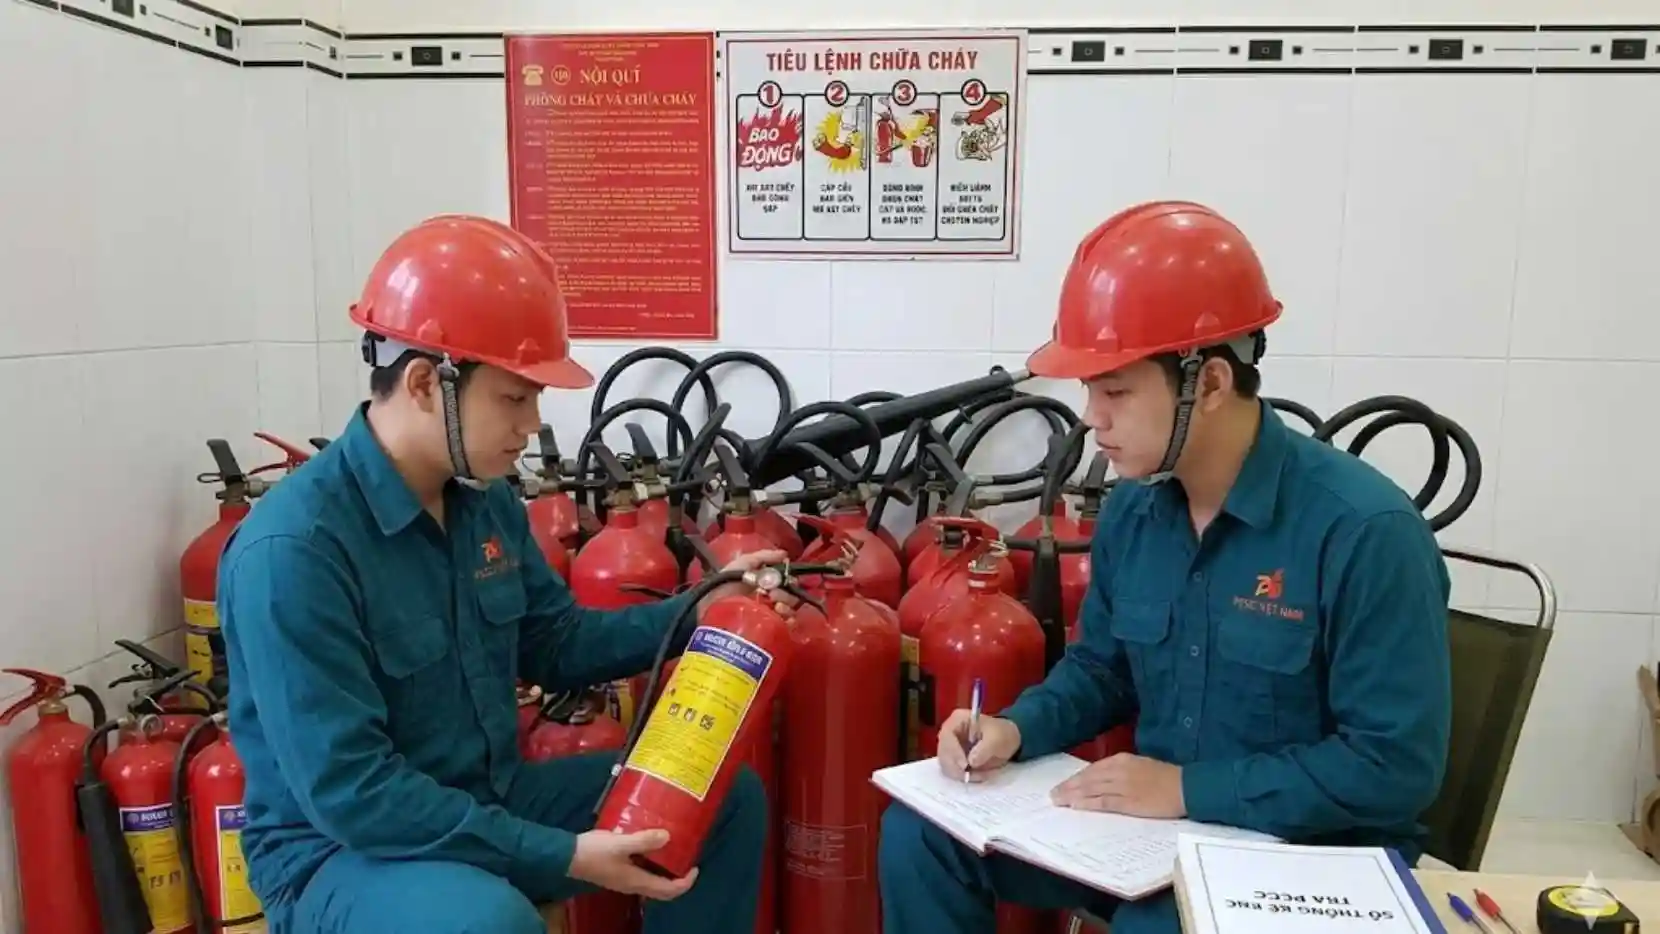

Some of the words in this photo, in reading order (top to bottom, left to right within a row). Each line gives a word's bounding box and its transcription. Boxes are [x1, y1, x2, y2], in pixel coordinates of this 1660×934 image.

[766, 48, 806, 71] TIÊU
[814, 48, 861, 75] LỆNH
[869, 47, 921, 71] CHỮA
[928, 47, 978, 71] CHÁY
[763, 86, 774, 104] 1
[830, 85, 844, 101] 2
[898, 85, 911, 101] 3
[968, 85, 981, 101] 4
